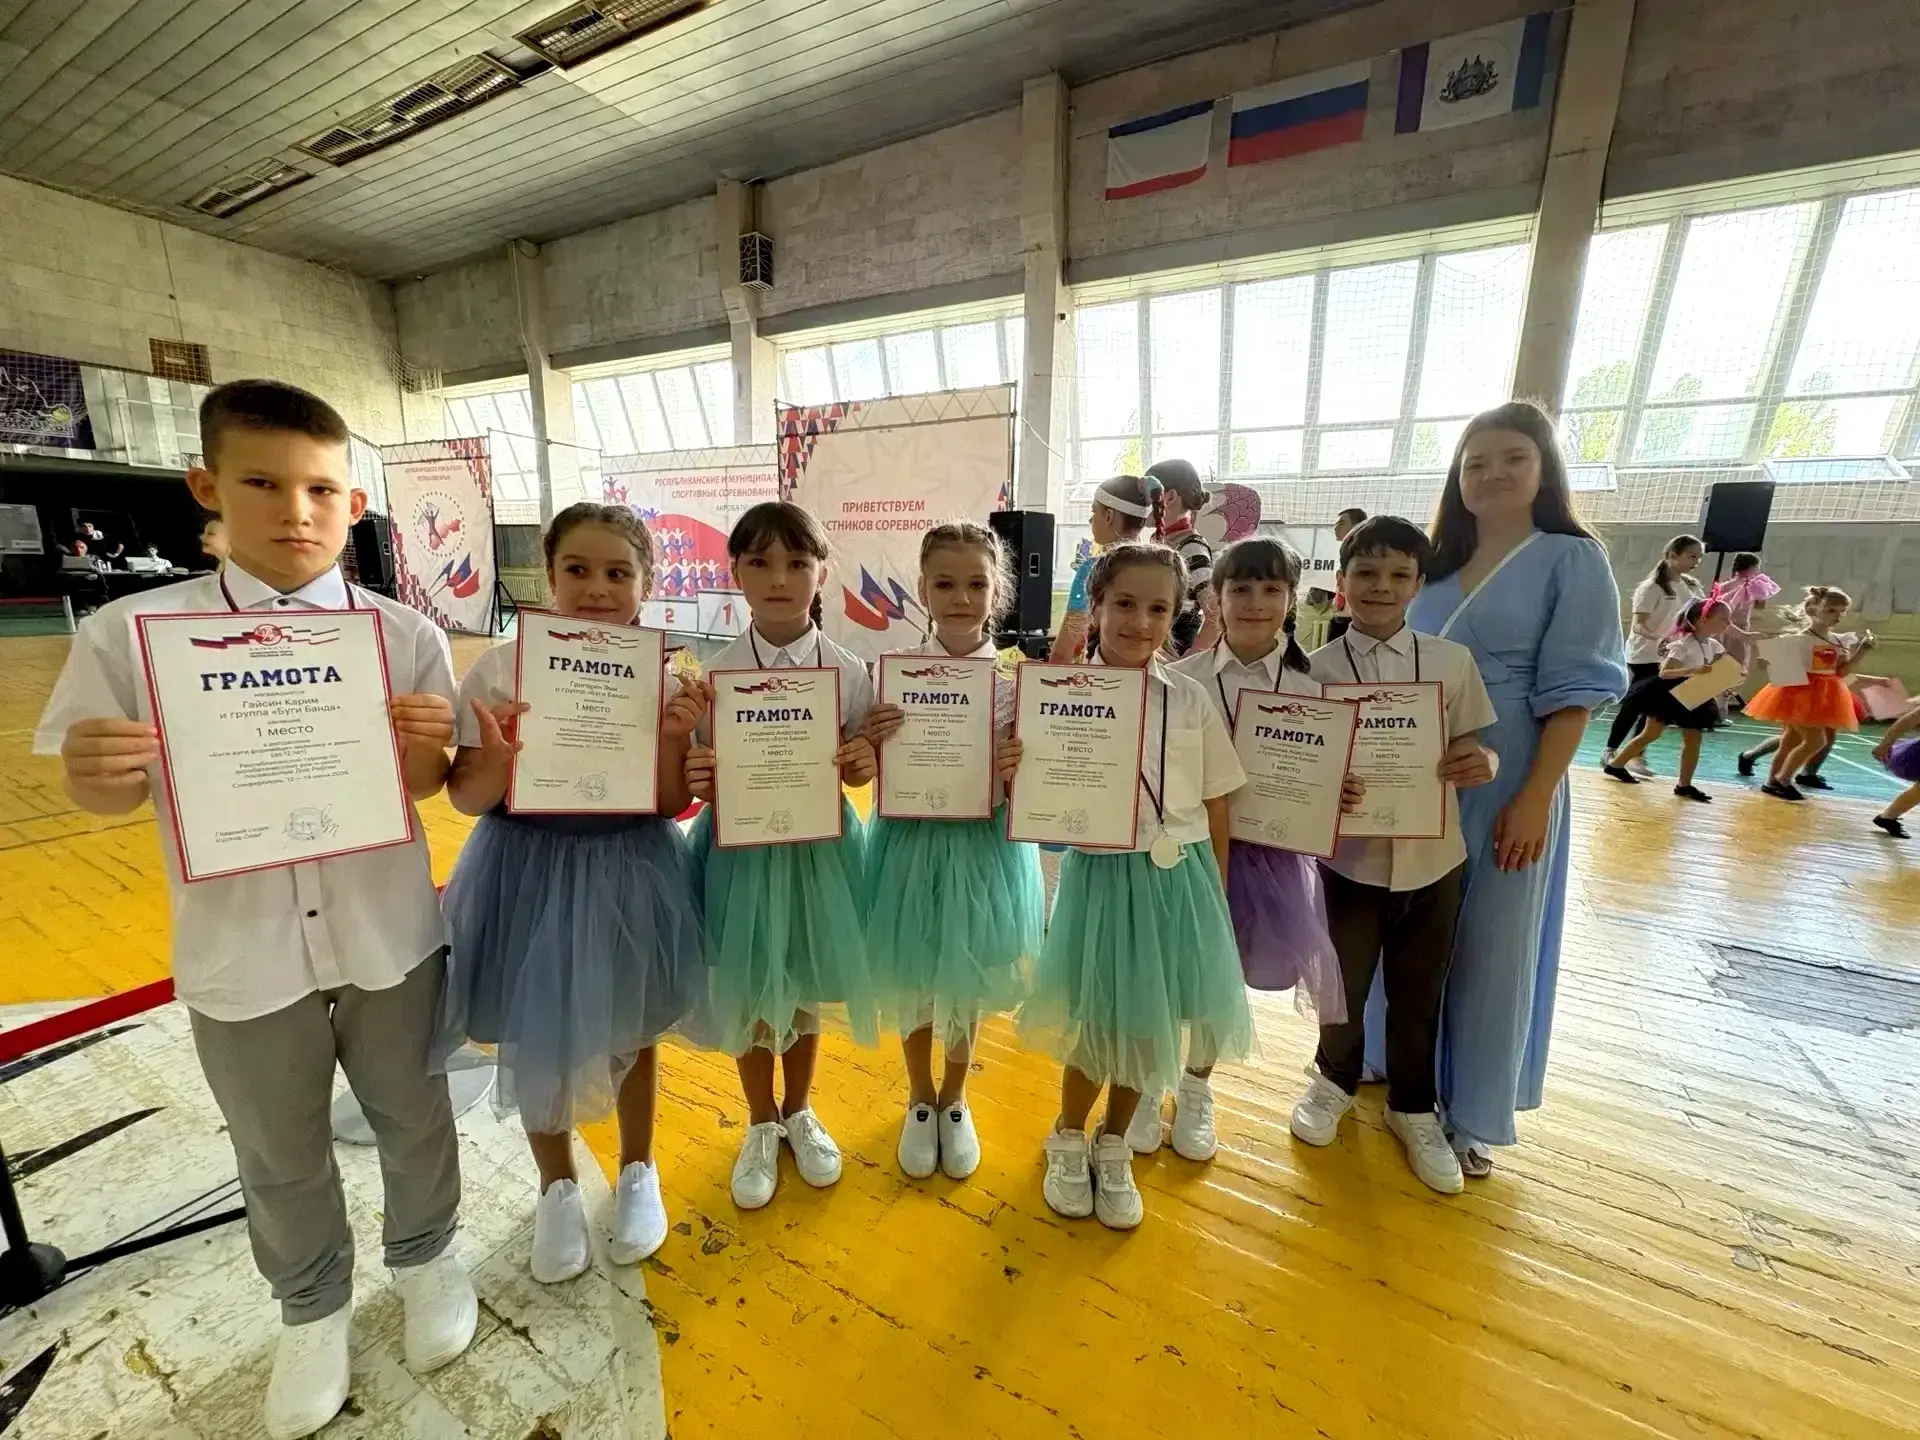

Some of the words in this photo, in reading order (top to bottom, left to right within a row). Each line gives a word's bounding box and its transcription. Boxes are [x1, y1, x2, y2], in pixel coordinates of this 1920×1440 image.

[654, 474, 720, 487] РЕСПУБЛИКАНСКИЕ
[720, 474, 728, 483] И
[728, 473, 779, 486] МУНИЦИПАЛ
[671, 489, 717, 499] СПОРТИВНЫЕ
[715, 504, 750, 512] АКРОБАТИ
[842, 500, 925, 513] ПРИВЕТСТВУЕМ
[823, 520, 873, 531] СТНИКОВ
[665, 608, 675, 624] 2
[722, 603, 732, 626] 1
[548, 656, 635, 679] ГРАМОТА
[200, 666, 343, 691] ГРАМОТА
[242, 700, 282, 709] Гайсин
[284, 697, 319, 708] Карим
[902, 691, 970, 705] ГРАМОТА
[219, 711, 227, 719] и
[230, 708, 269, 720] группа
[271, 706, 302, 717] «Буги
[304, 704, 341, 713] Банда»
[575, 702, 580, 710] 1
[582, 704, 611, 713] место
[1039, 702, 1117, 719] ГРАМОТА
[736, 707, 813, 723] ГРАМОТА
[1356, 717, 1417, 729] РАМОТА
[256, 727, 263, 737] 1
[267, 724, 315, 737] место
[1254, 725, 1325, 747] ГРАМОТА
[761, 749, 765, 757] 1
[767, 749, 794, 757] место
[1061, 743, 1065, 751] 1
[1067, 746, 1094, 754] место
[1276, 764, 1301, 774] место
